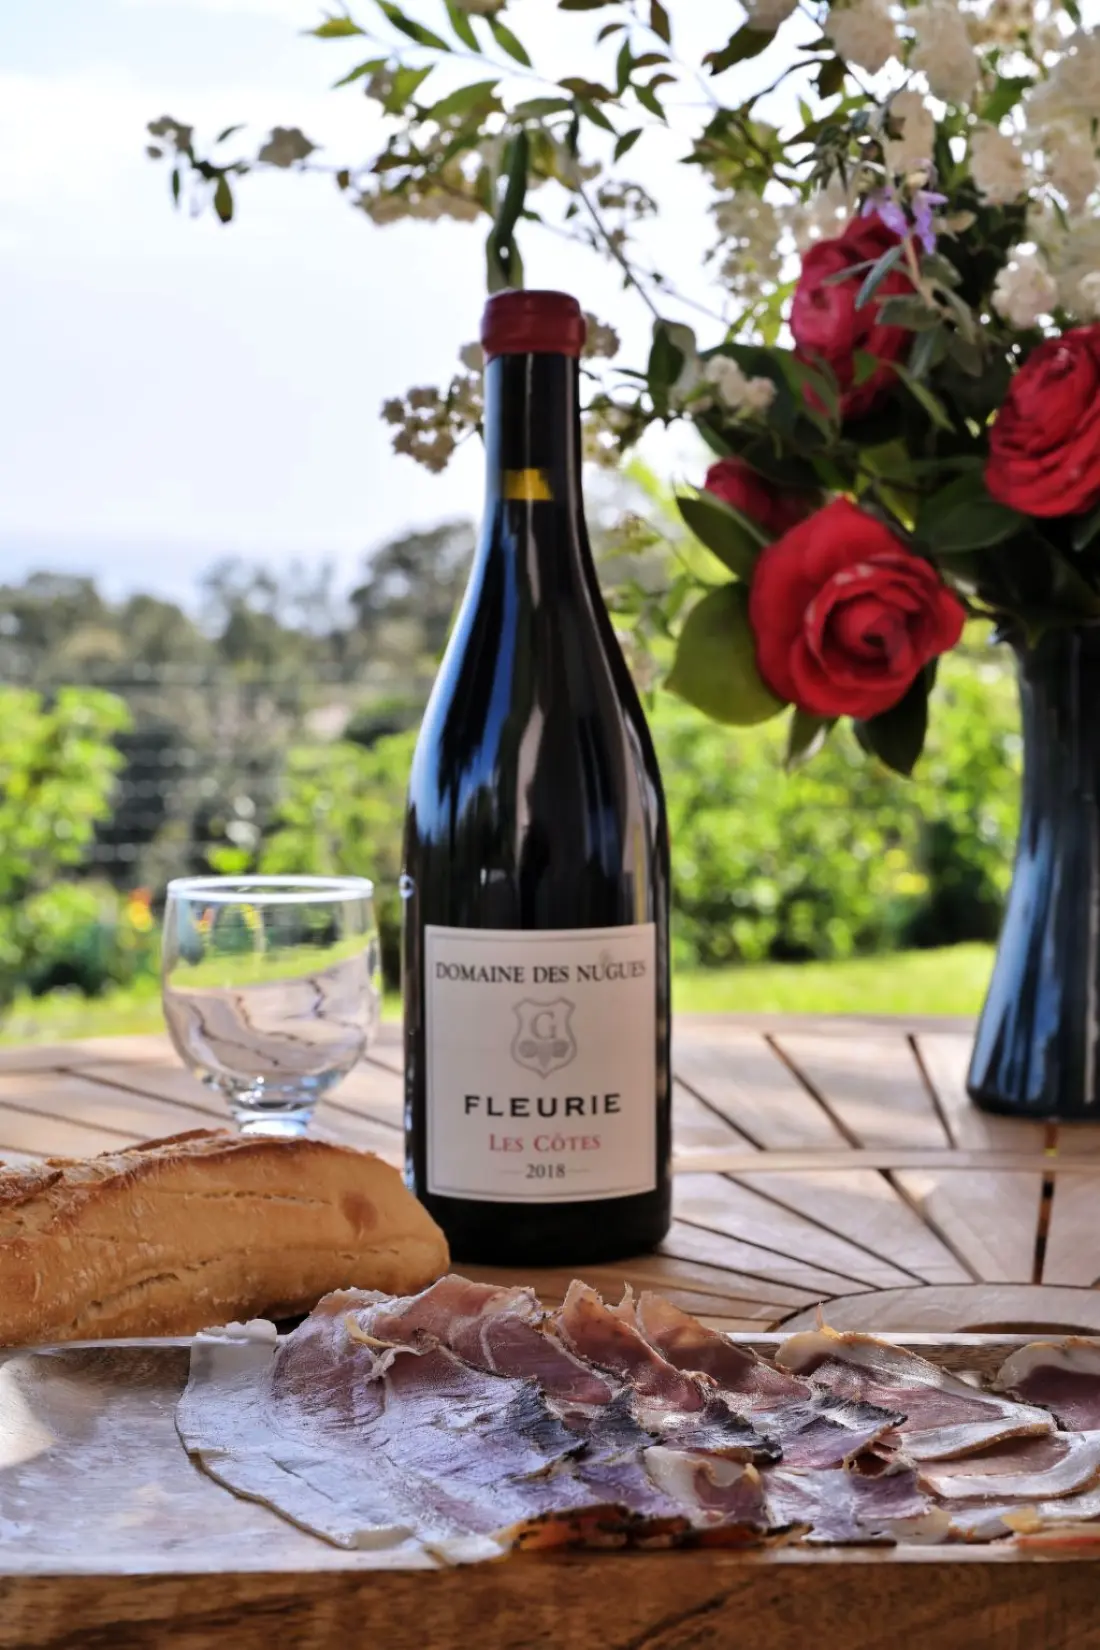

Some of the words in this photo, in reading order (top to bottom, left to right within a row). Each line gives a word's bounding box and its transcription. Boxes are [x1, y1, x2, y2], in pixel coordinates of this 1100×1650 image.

[435, 961, 525, 984] DOMAINE
[533, 965, 570, 984] DES
[576, 959, 647, 983] NUGUES
[530, 1010, 557, 1041] G
[464, 1092, 622, 1118] FLEURIE
[488, 1132, 524, 1153] LES
[525, 1163, 566, 1179] 2018
